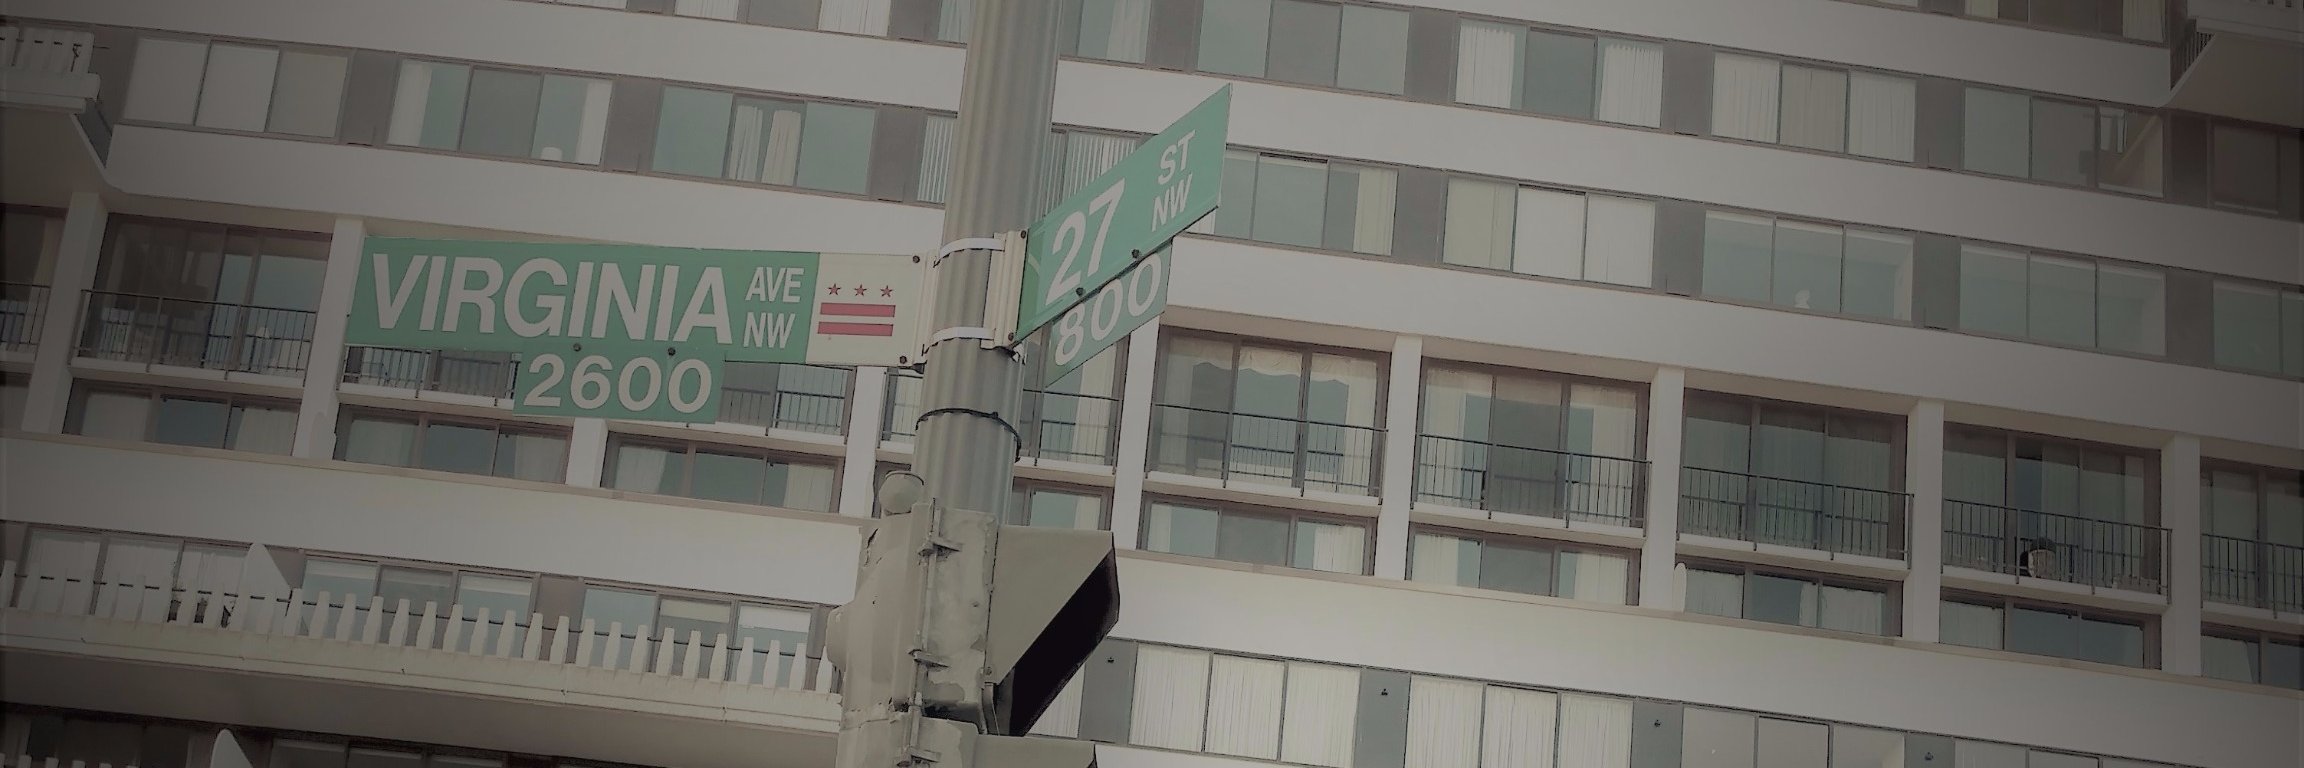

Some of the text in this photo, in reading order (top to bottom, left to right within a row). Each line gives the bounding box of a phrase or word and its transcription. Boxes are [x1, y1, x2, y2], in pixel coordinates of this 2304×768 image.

[1157, 130, 1196, 185] ST
[1152, 173, 1193, 232] NW
[1045, 178, 1126, 306] 27
[371, 252, 733, 345] VIRGINIA
[744, 266, 804, 303] AVE
[1055, 253, 1162, 366] 800
[742, 311, 796, 349] NW
[523, 353, 713, 413] 2600
